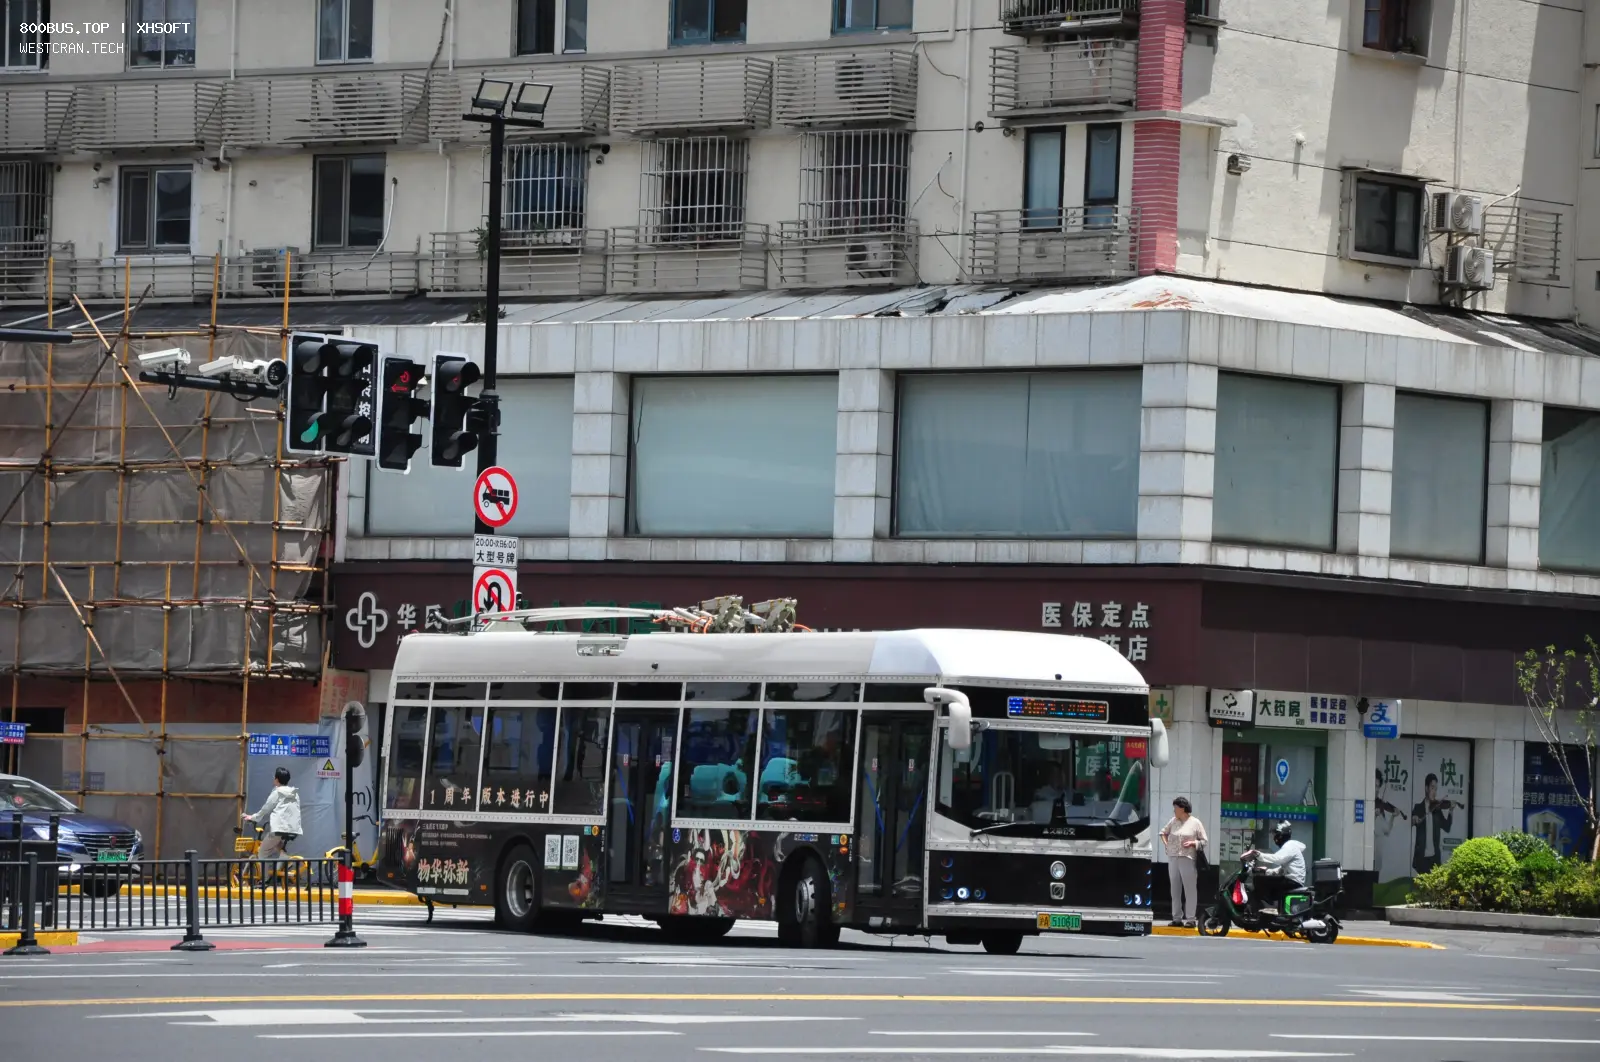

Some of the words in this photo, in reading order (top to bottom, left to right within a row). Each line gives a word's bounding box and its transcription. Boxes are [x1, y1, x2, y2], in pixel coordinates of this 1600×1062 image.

[475, 550, 516, 564] 大型号牌
[1041, 601, 1151, 628] 医保定点
[1259, 698, 1301, 718] 大药房
[417, 858, 470, 885] 物华弥新
